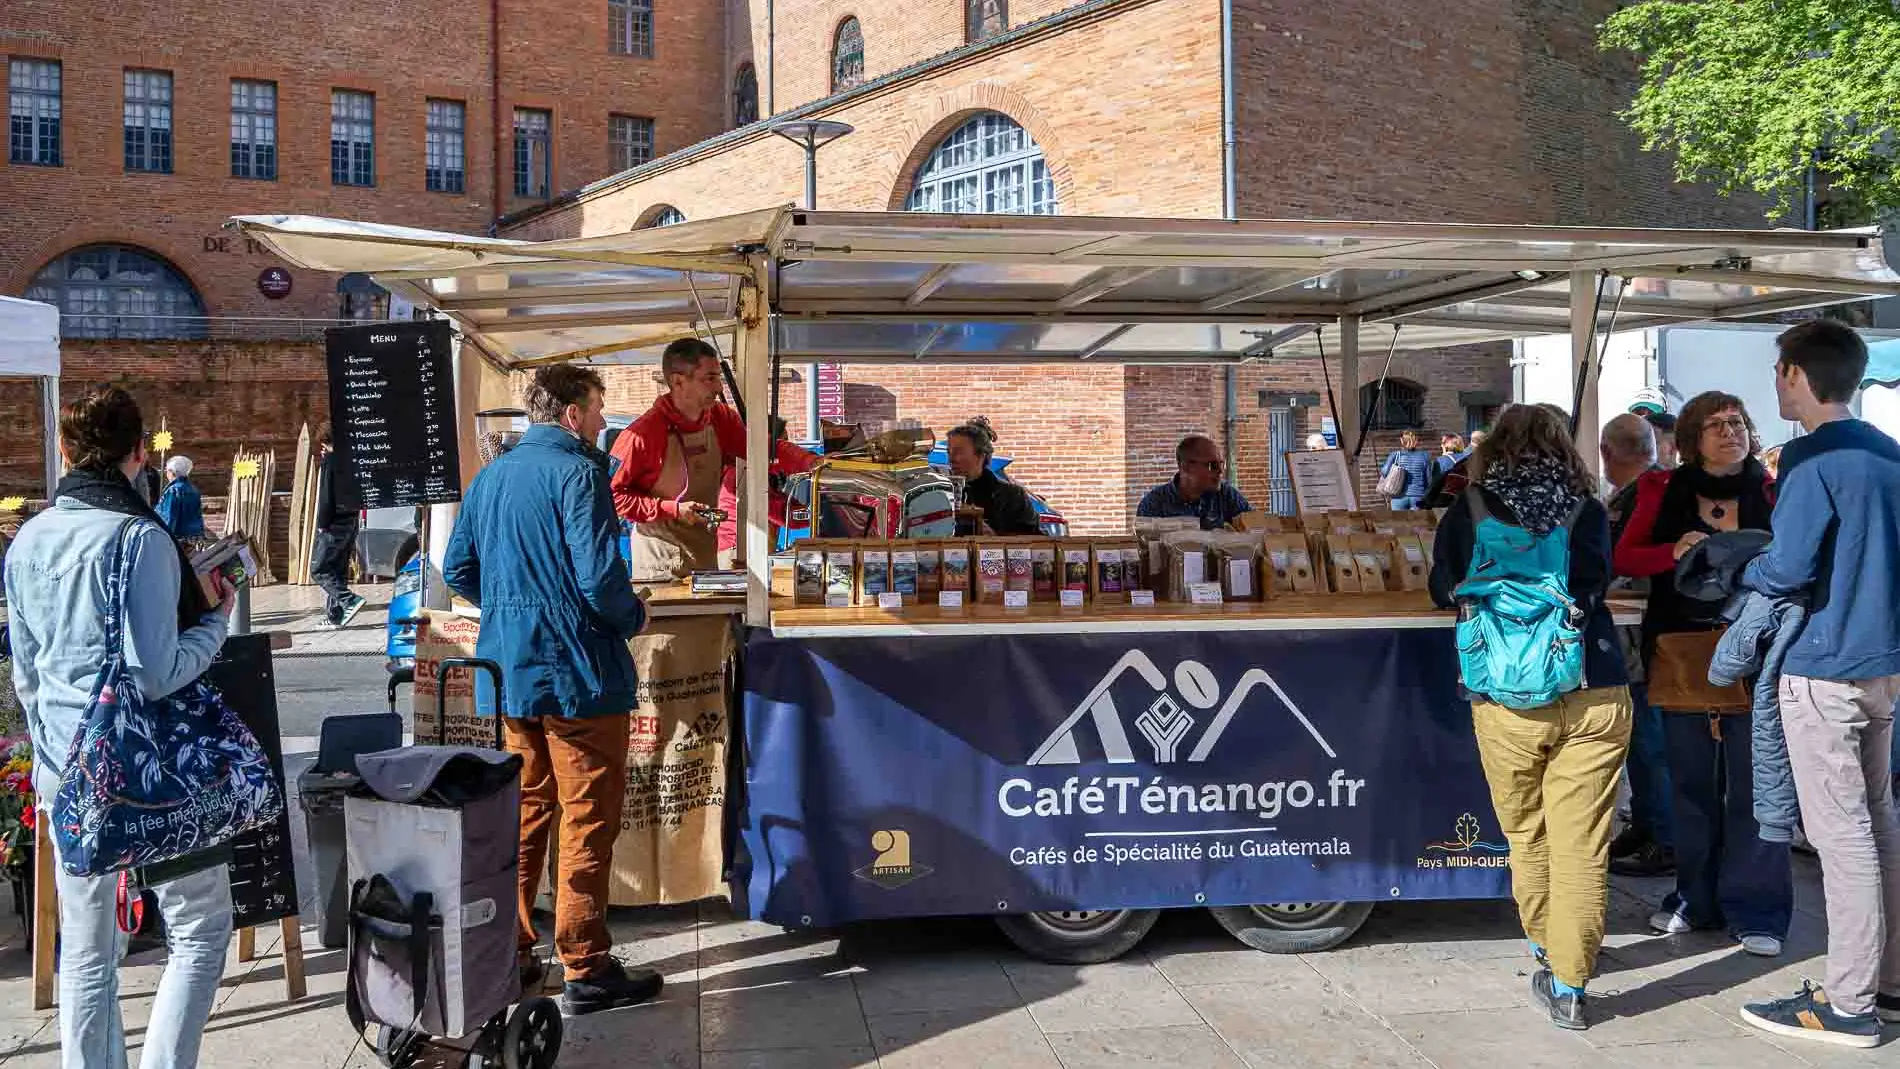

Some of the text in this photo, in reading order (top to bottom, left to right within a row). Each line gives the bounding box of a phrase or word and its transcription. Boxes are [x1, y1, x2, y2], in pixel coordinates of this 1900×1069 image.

[204, 237, 230, 253] DE
[370, 334, 397, 343] MENU
[998, 768, 1365, 819] CaféTénango.fr
[124, 820, 137, 835] la
[140, 814, 165, 839] fée
[1010, 837, 1352, 866] Cafés de Spécialité du Guatemala
[873, 866, 911, 875] ARTISAN
[1417, 857, 1443, 870] Pays
